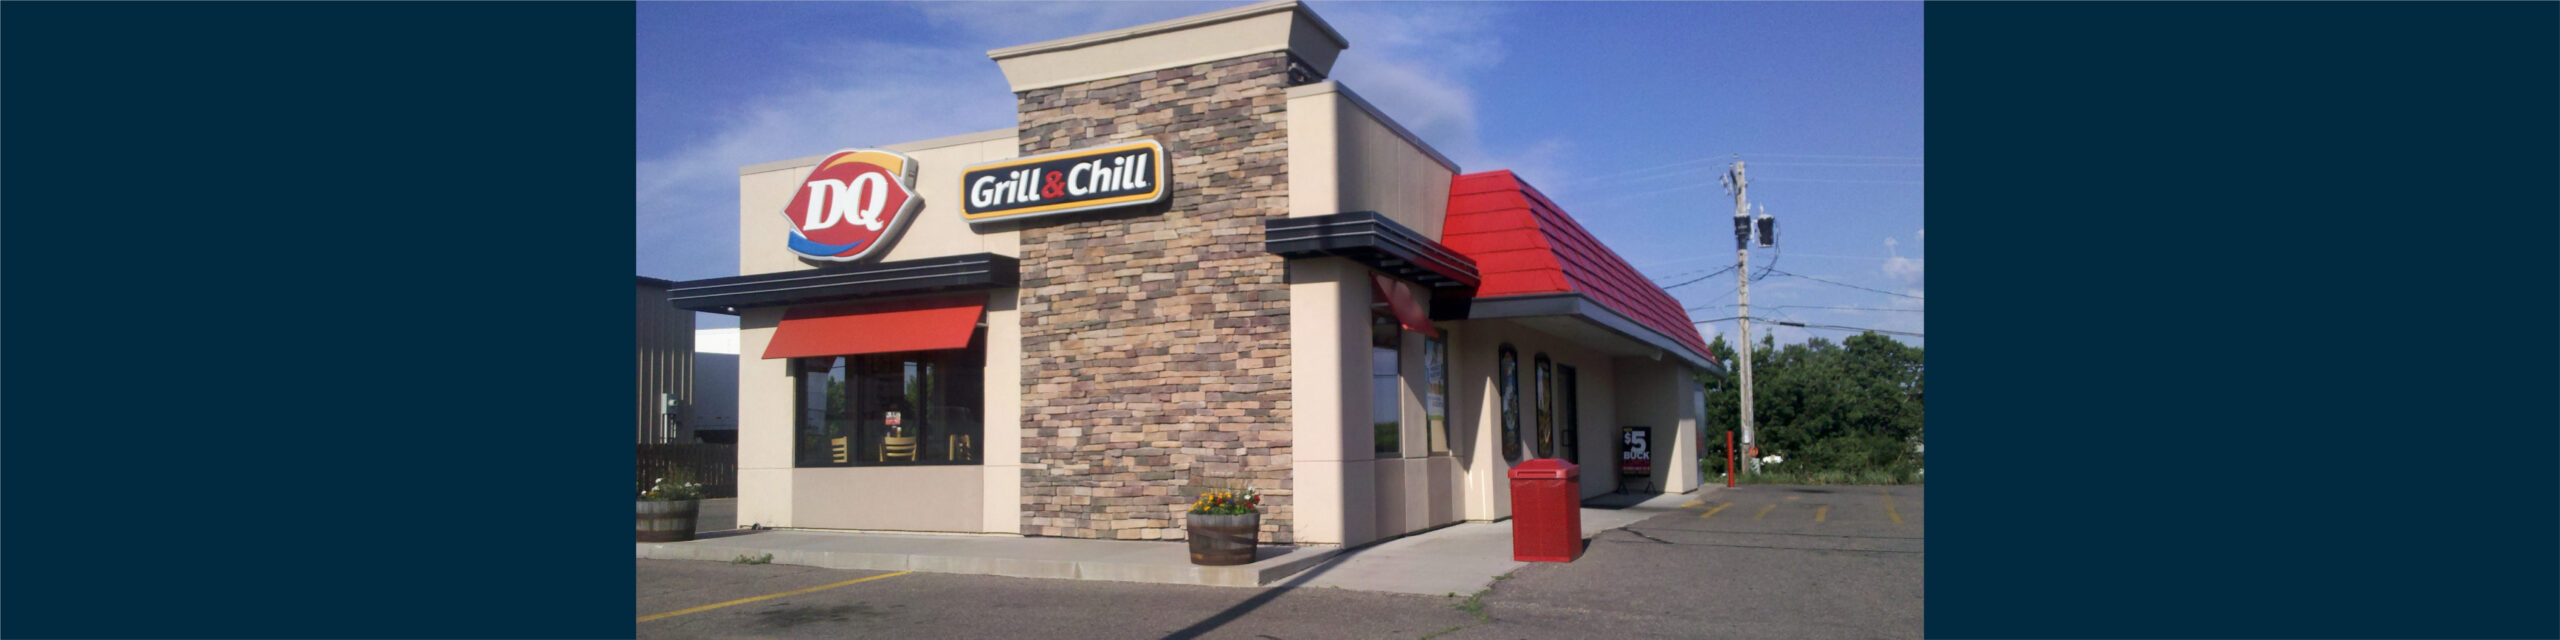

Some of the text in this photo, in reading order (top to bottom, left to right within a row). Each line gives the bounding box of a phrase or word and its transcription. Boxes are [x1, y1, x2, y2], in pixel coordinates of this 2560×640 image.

[803, 171, 885, 232] DQ
[1624, 430, 1647, 453] $5
[1623, 451, 1650, 460] BUCK
